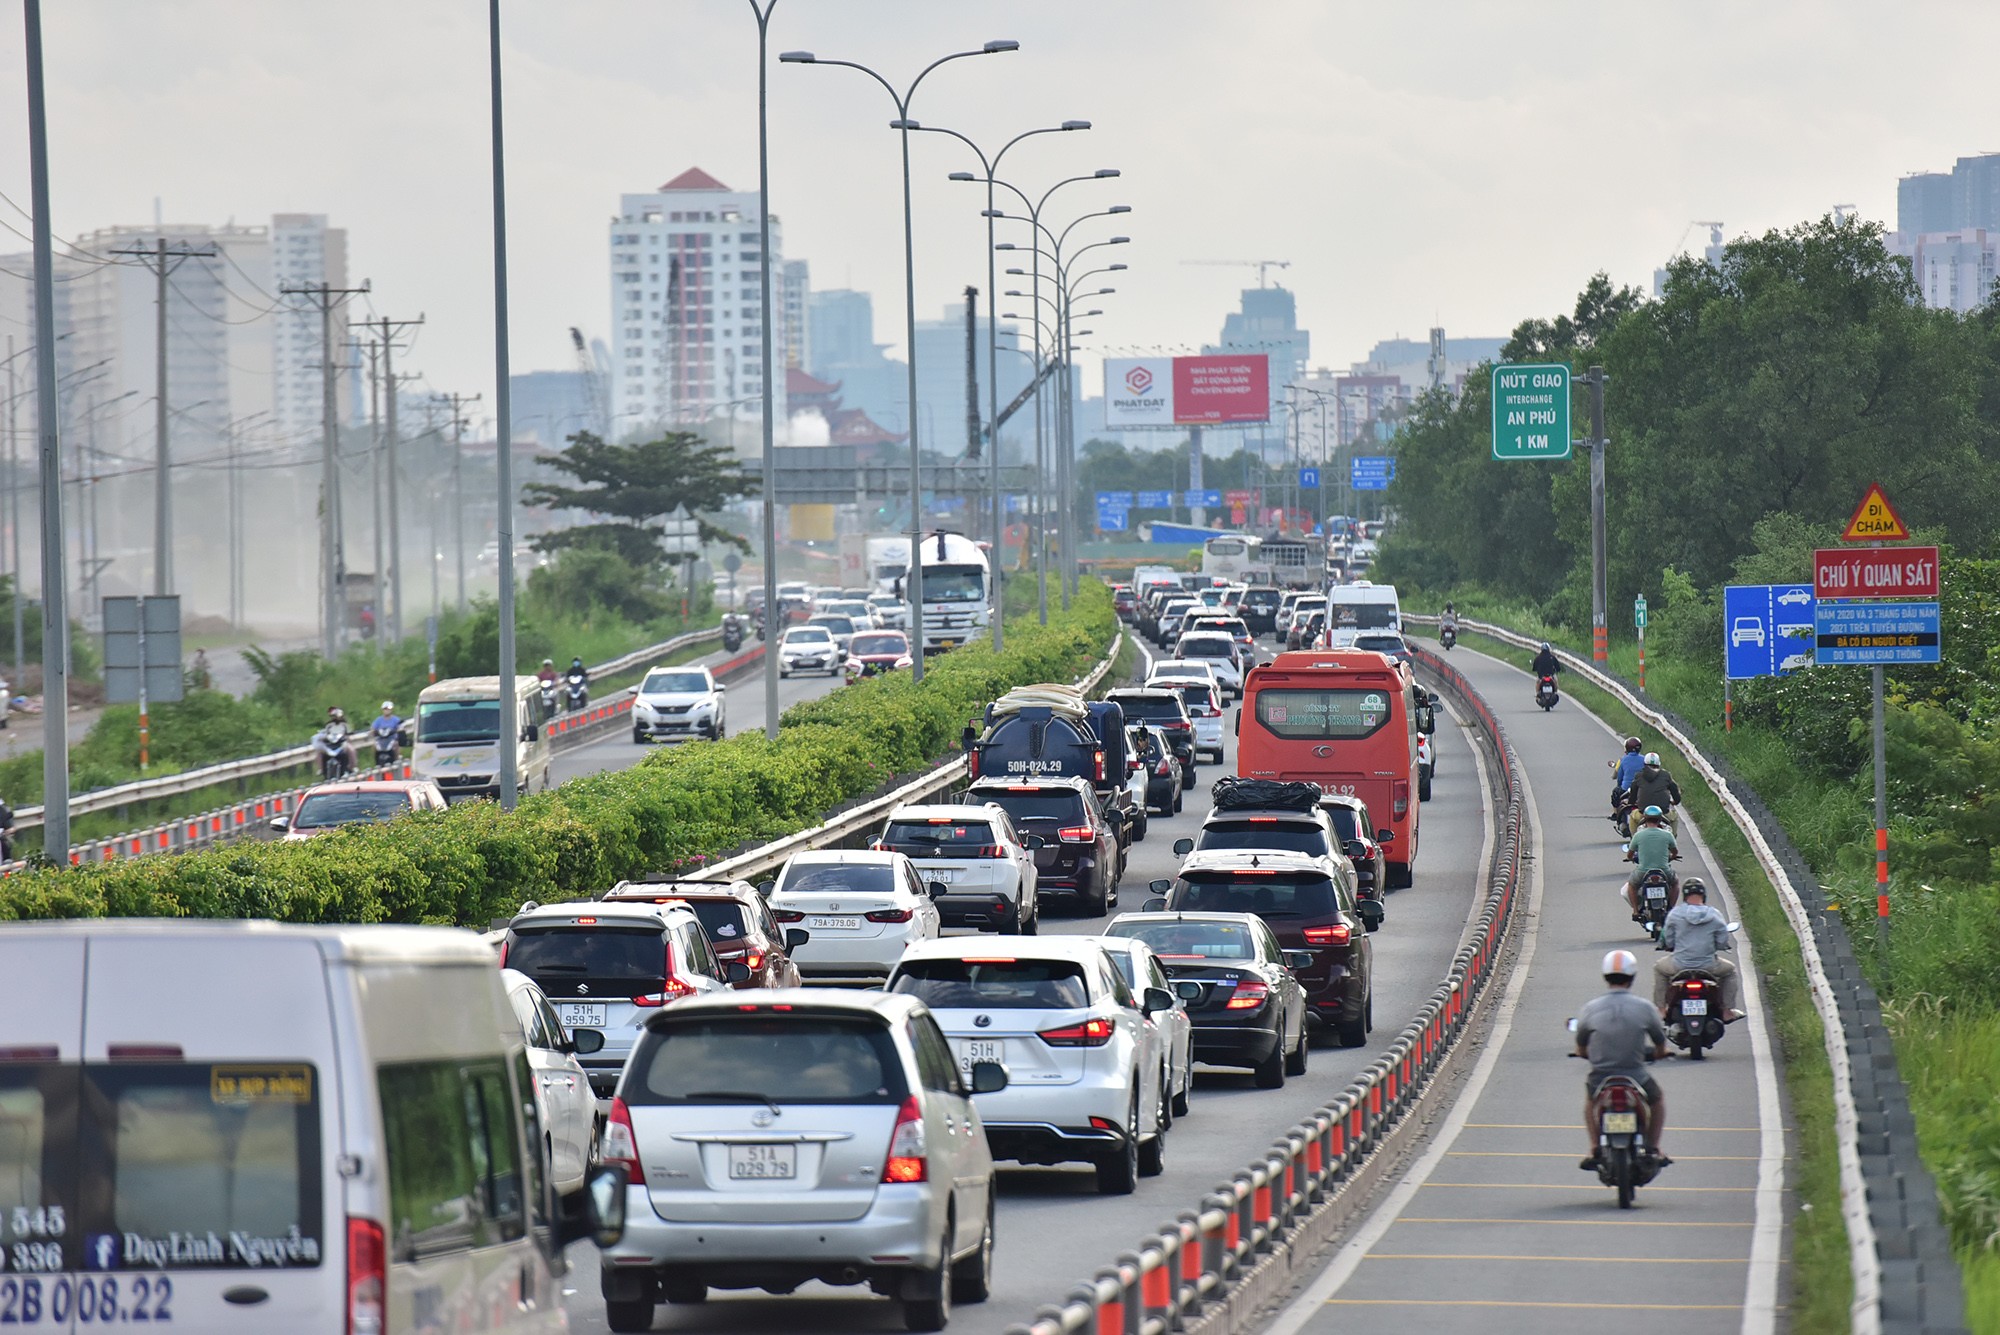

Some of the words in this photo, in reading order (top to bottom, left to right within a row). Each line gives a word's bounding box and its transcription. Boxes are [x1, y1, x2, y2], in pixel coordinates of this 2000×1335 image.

[1501, 372, 1527, 388] NÚT
[1533, 374, 1562, 388] GIAO
[1506, 394, 1552, 405] INTERCHANGE
[1507, 411, 1525, 425] AN
[1530, 407, 1556, 425] PHÚ
[1515, 435, 1521, 449] 1
[1527, 434, 1548, 449] KM
[1869, 504, 1882, 516] ĐI
[1820, 559, 1848, 588] CHÚ
[1851, 559, 1861, 587] Ý
[1864, 563, 1902, 587] QUAN
[1906, 558, 1933, 587] SÁT
[1637, 611, 1644, 625] 1
[1836, 609, 1855, 620] 2020
[1868, 609, 1873, 619] 3
[1829, 623, 1847, 633] 2021
[1861, 636, 1871, 647] 03
[1367, 695, 1378, 703] 68
[1007, 760, 1062, 772] 50H-024.29
[813, 919, 856, 927] 79A-379.06
[573, 1005, 593, 1015] 51H
[565, 1015, 601, 1025] 959.75
[970, 1043, 994, 1057] 51H
[749, 1147, 777, 1161] 51A
[736, 1161, 789, 1176] 029.79
[11, 1205, 66, 1238] 545
[11, 1241, 63, 1273] 336
